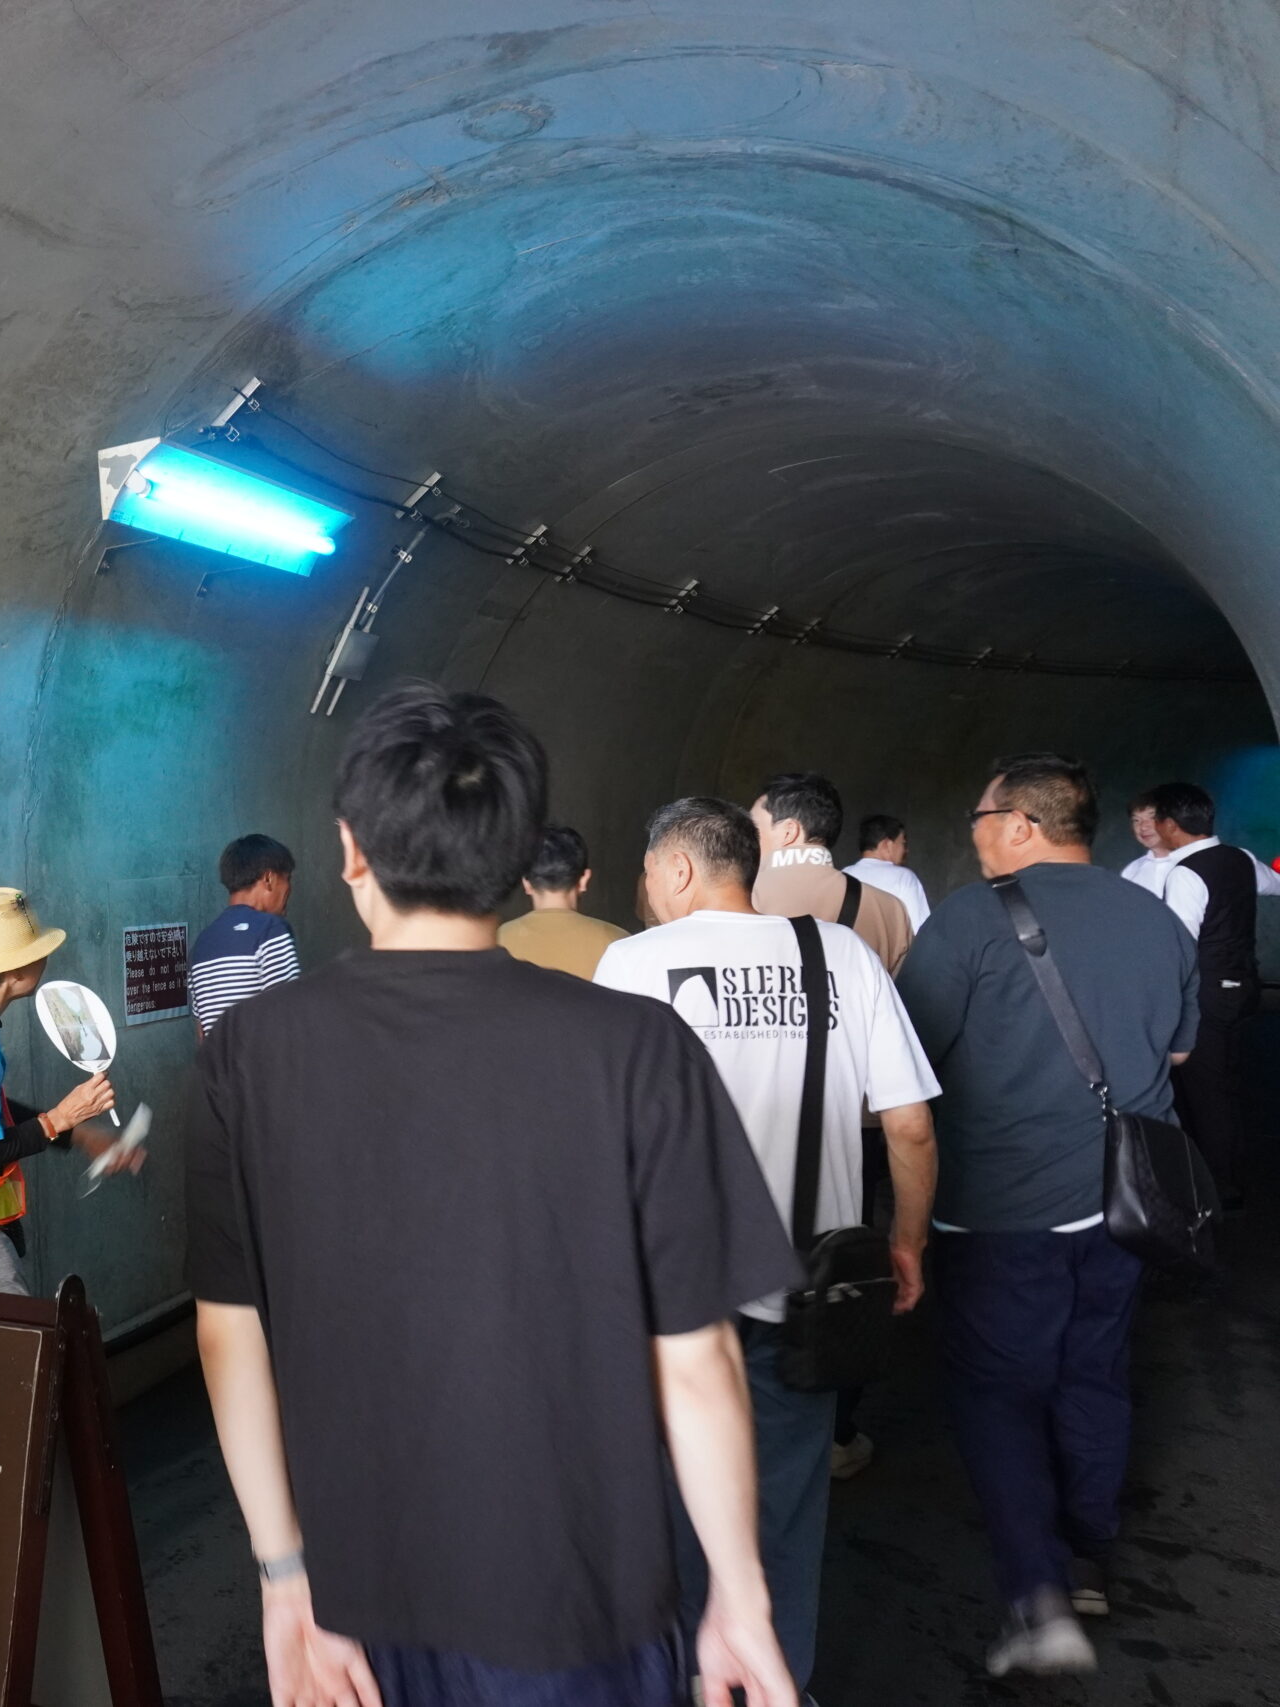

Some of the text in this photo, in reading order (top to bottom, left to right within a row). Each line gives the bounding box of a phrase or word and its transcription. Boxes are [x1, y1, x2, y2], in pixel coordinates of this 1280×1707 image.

[126, 967, 145, 978] Please
[149, 967, 156, 976] do
[160, 963, 170, 974] not
[127, 985, 139, 996] over
[142, 983, 151, 994] the
[152, 981, 167, 992] fence
[169, 980, 175, 990] as
[722, 965, 840, 999] SIERA
[127, 1000, 156, 1013] dangerous.
[724, 995, 840, 1031] DESIGS
[704, 1029, 809, 1040] ESTABLISHED 196
